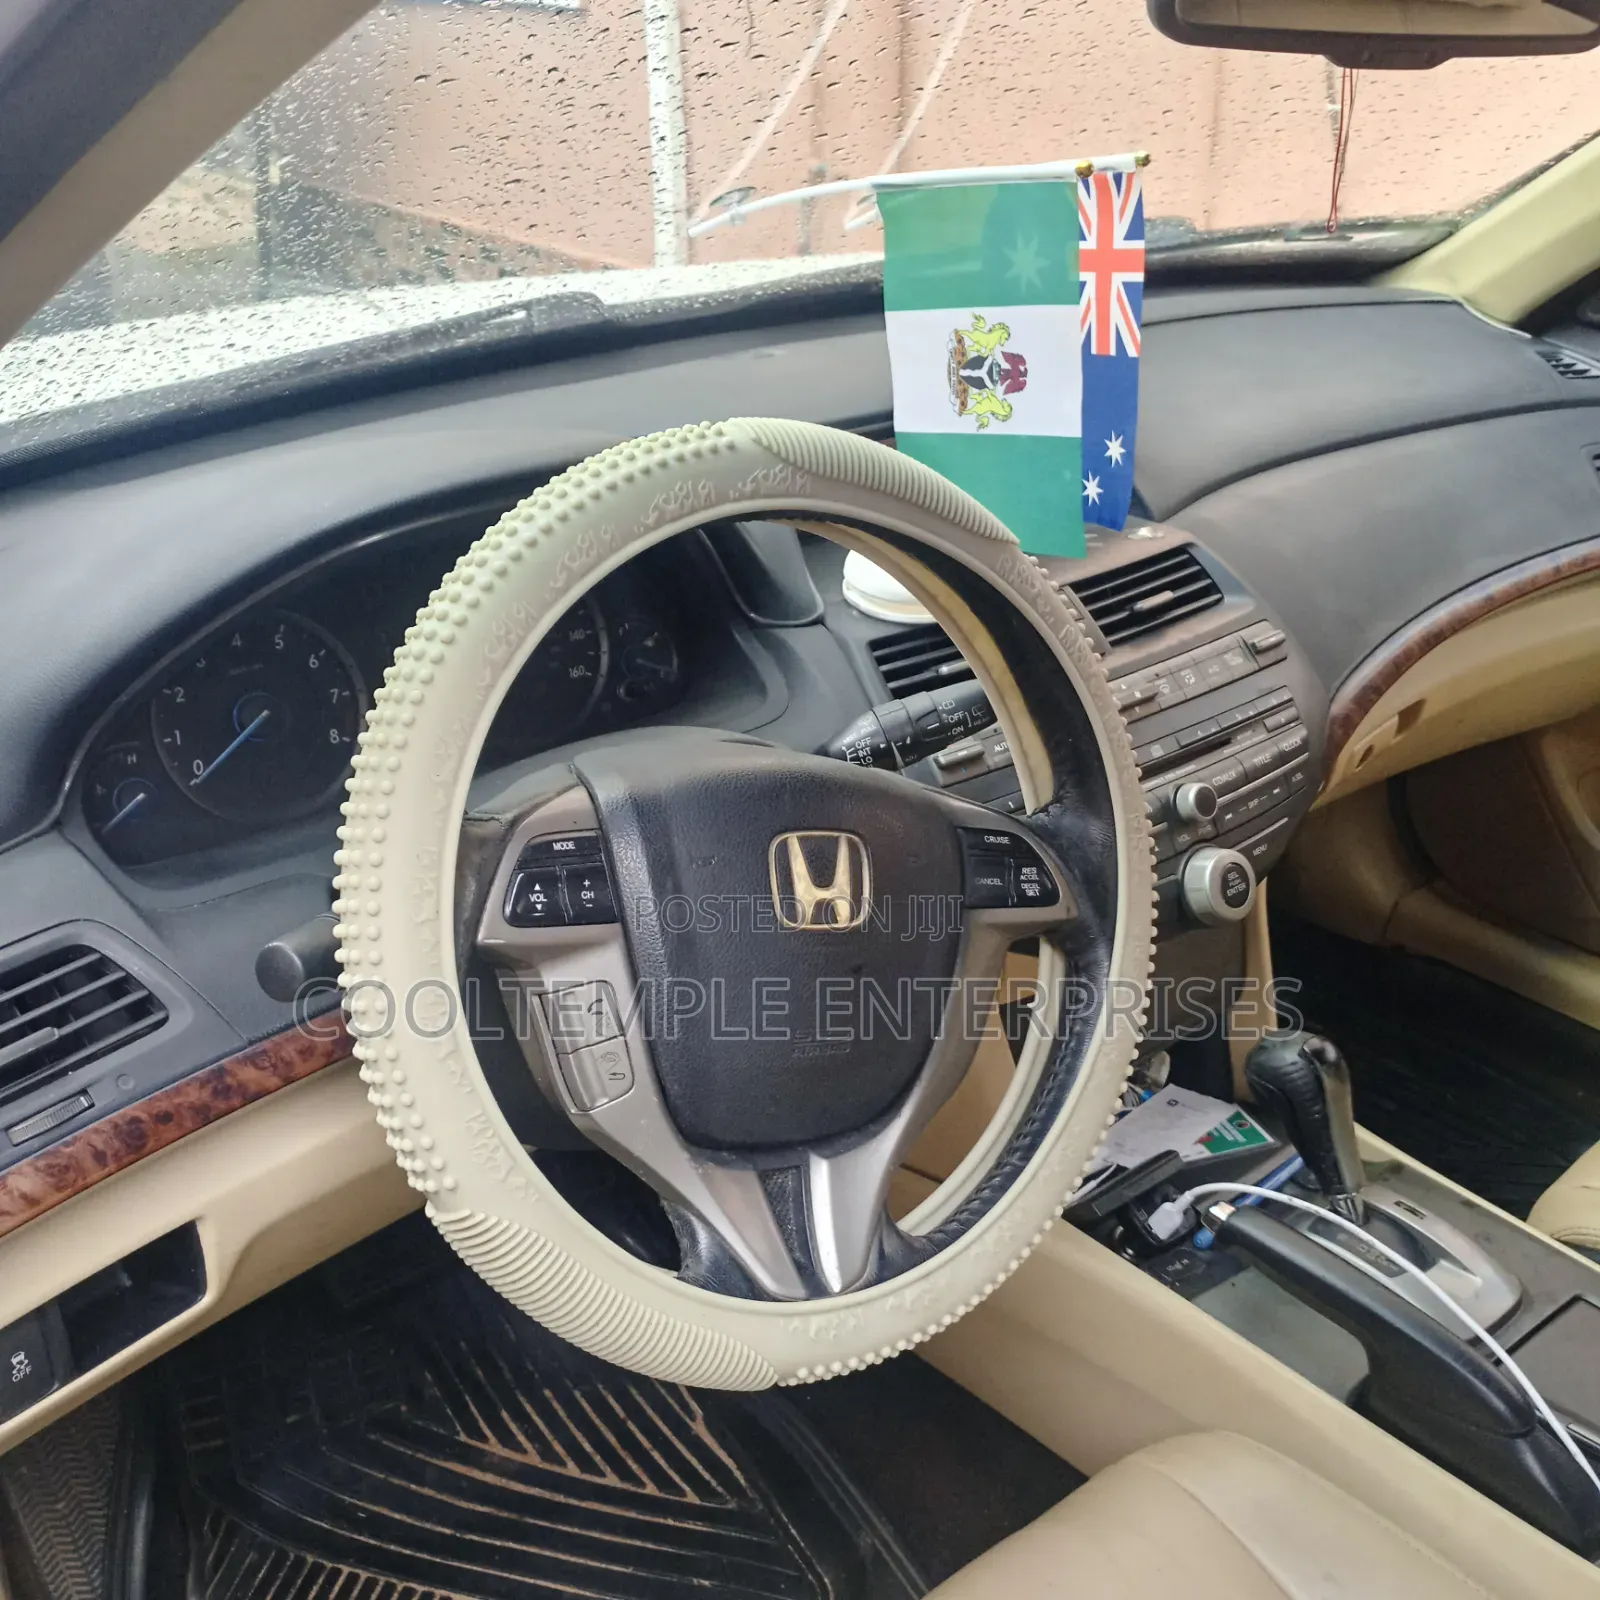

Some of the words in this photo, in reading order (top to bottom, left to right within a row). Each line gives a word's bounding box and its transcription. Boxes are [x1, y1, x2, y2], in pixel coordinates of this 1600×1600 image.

[231, 632, 242, 647] 4
[274, 634, 284, 649] 5
[568, 628, 586, 642] 140
[308, 654, 319, 669] 6
[568, 664, 585, 678] 160
[175, 686, 186, 703] 2
[330, 688, 339, 703] 7
[948, 710, 965, 723] OFF
[330, 728, 340, 743] 8
[952, 725, 964, 735] ON
[174, 730, 181, 746] 1
[855, 736, 872, 749] OFF
[857, 747, 871, 757] INT
[993, 741, 1009, 753] AUT
[860, 756, 873, 765] LO
[1252, 753, 1273, 767] TITLE
[192, 759, 204, 776] 0
[552, 840, 576, 851] MODE
[984, 835, 1011, 845] CRUISE
[1252, 843, 1269, 857] MENU
[975, 877, 1003, 886] CANCEL
[1227, 871, 1240, 881] SEL
[581, 890, 594, 899] CH
[1025, 888, 1040, 897] SET
[1226, 882, 1247, 896] ENTER
[528, 893, 547, 902] VOL
[12, 1364, 32, 1382] OFF
